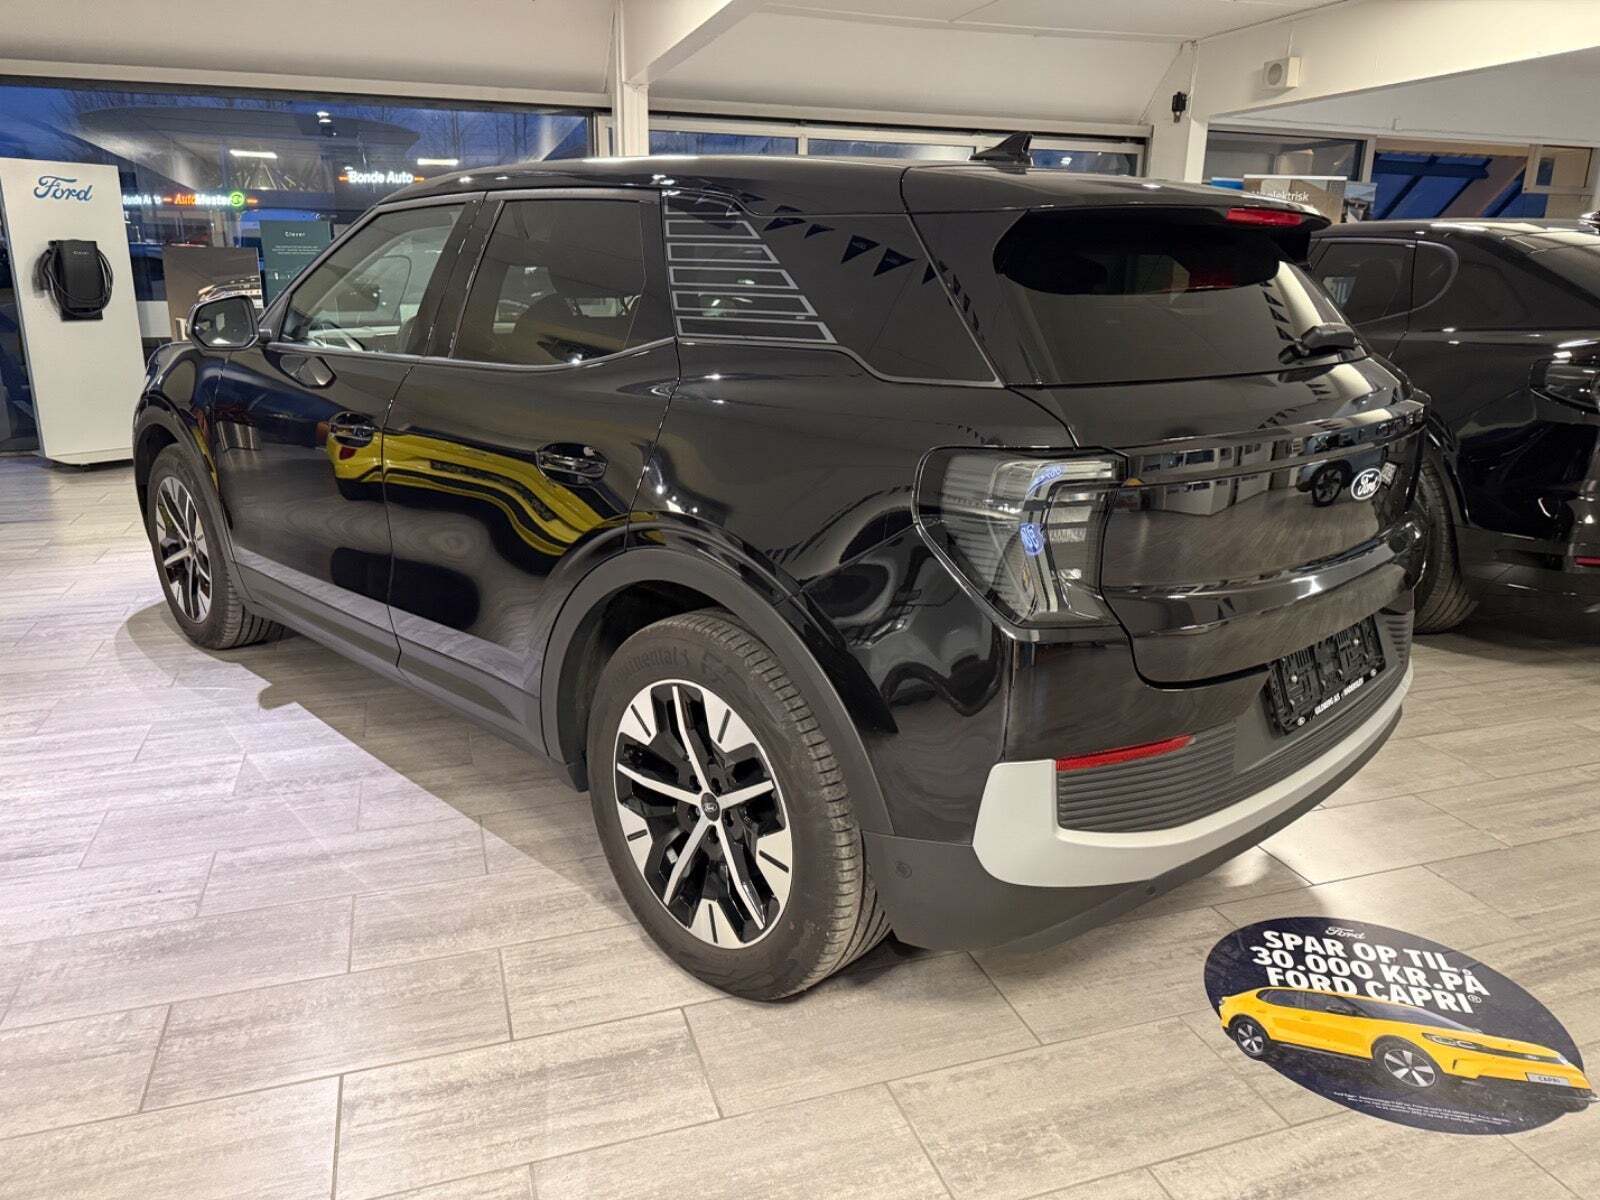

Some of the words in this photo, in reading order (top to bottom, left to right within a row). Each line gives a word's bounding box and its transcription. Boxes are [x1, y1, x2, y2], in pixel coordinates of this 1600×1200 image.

[34, 176, 93, 201] Ford
[347, 170, 385, 184] Bonde
[386, 171, 414, 184] Auto
[1325, 926, 1366, 939] Ford
[1262, 930, 1348, 958] SPAR
[1352, 943, 1398, 964] OP
[1403, 948, 1459, 972] TIL
[1250, 946, 1374, 980] 30.000
[1439, 968, 1491, 996] PÅ
[1265, 967, 1358, 995] FORD
